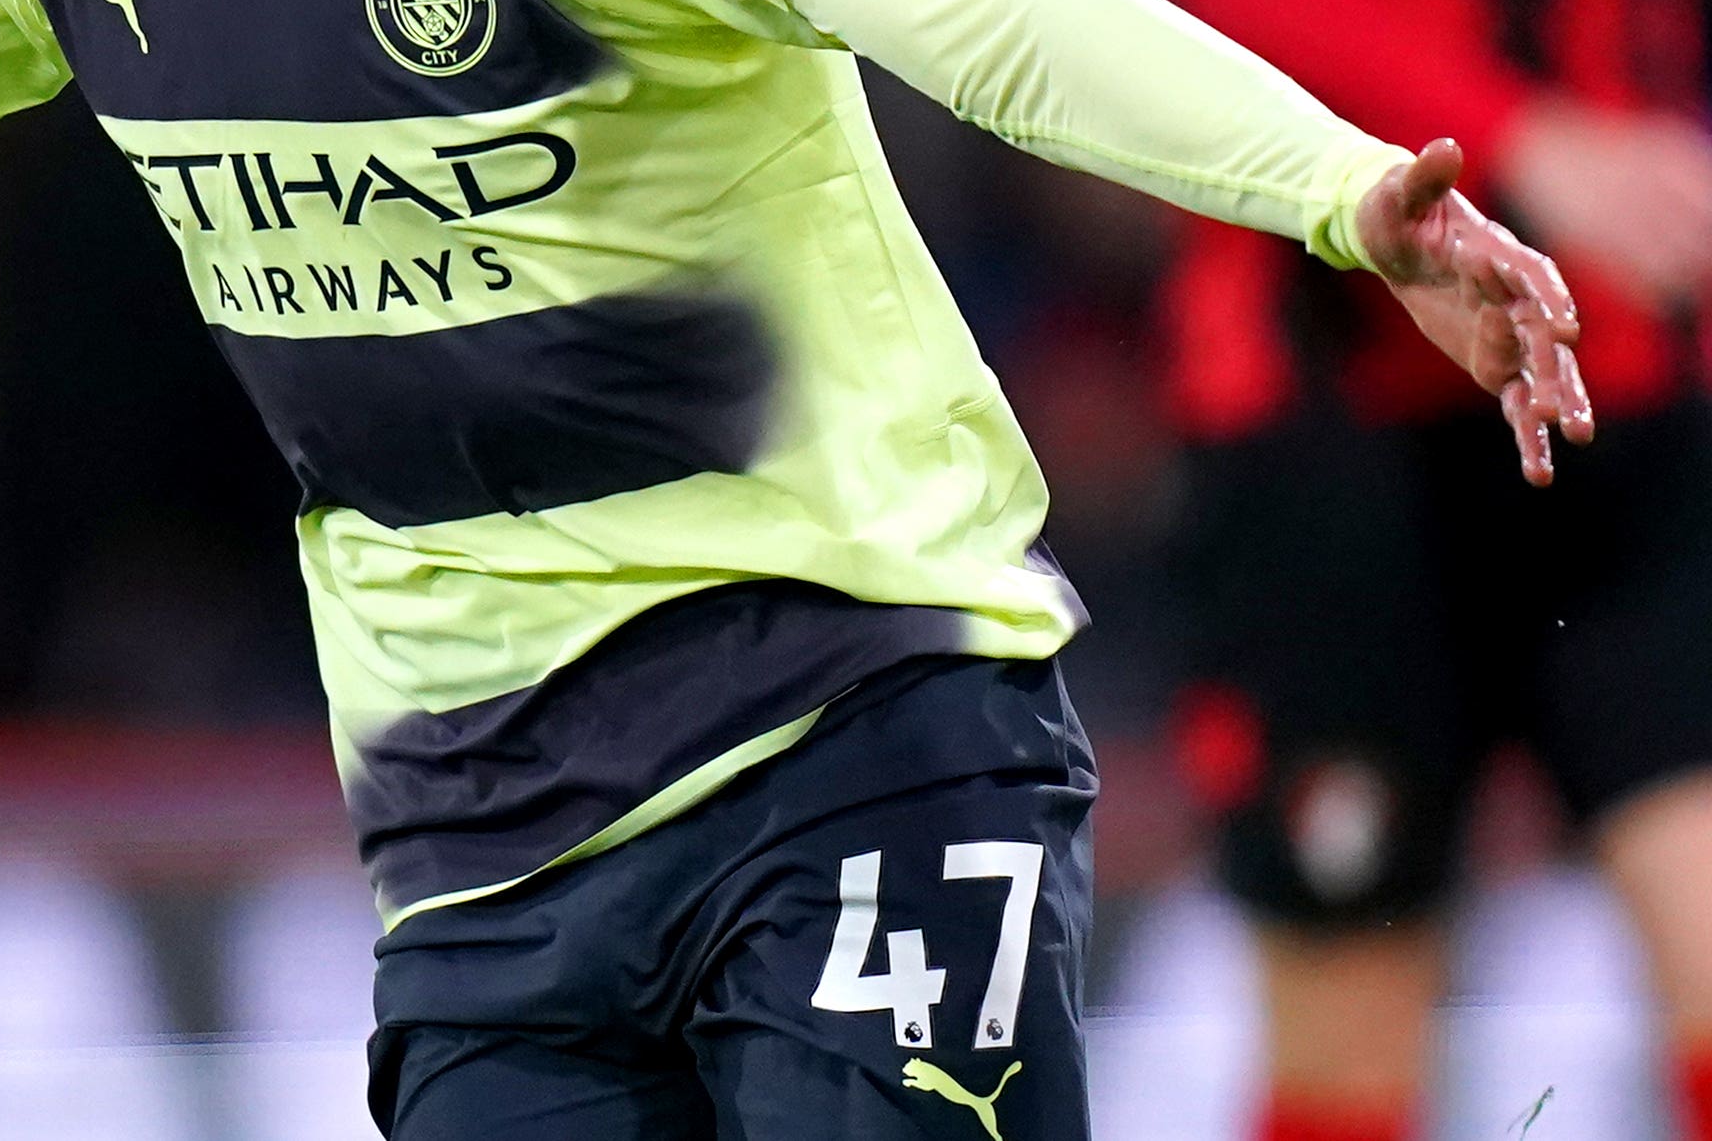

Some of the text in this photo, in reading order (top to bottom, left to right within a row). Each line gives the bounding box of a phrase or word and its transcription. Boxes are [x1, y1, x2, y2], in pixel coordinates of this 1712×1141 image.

[421, 49, 459, 65] CITY
[212, 245, 513, 315] AIRWAYS
[810, 840, 1045, 1050] 47
